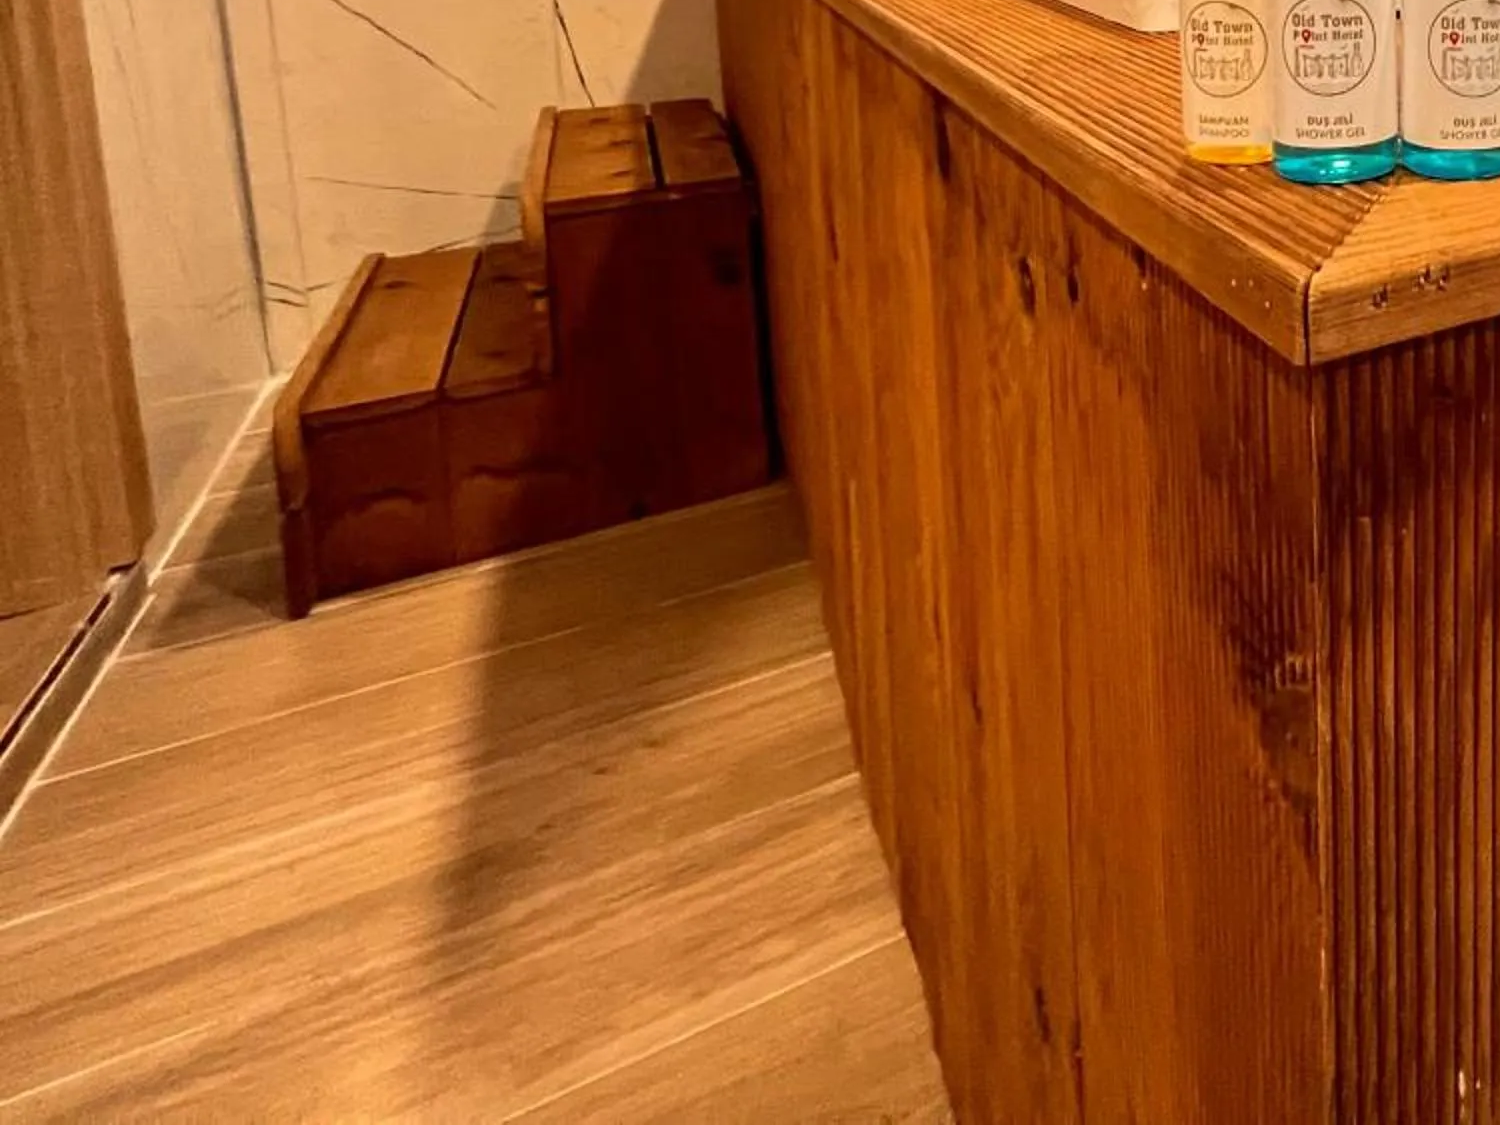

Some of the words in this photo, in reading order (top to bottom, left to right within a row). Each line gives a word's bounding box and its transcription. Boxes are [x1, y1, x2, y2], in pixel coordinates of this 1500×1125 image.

[1213, 20, 1253, 34] Town
[1291, 13, 1315, 28] Old
[1319, 14, 1363, 28] Town
[1441, 16, 1465, 30] Old
[1331, 29, 1363, 41] Hotel
[1295, 127, 1343, 139] SHOWER
[1345, 126, 1365, 138] GEL
